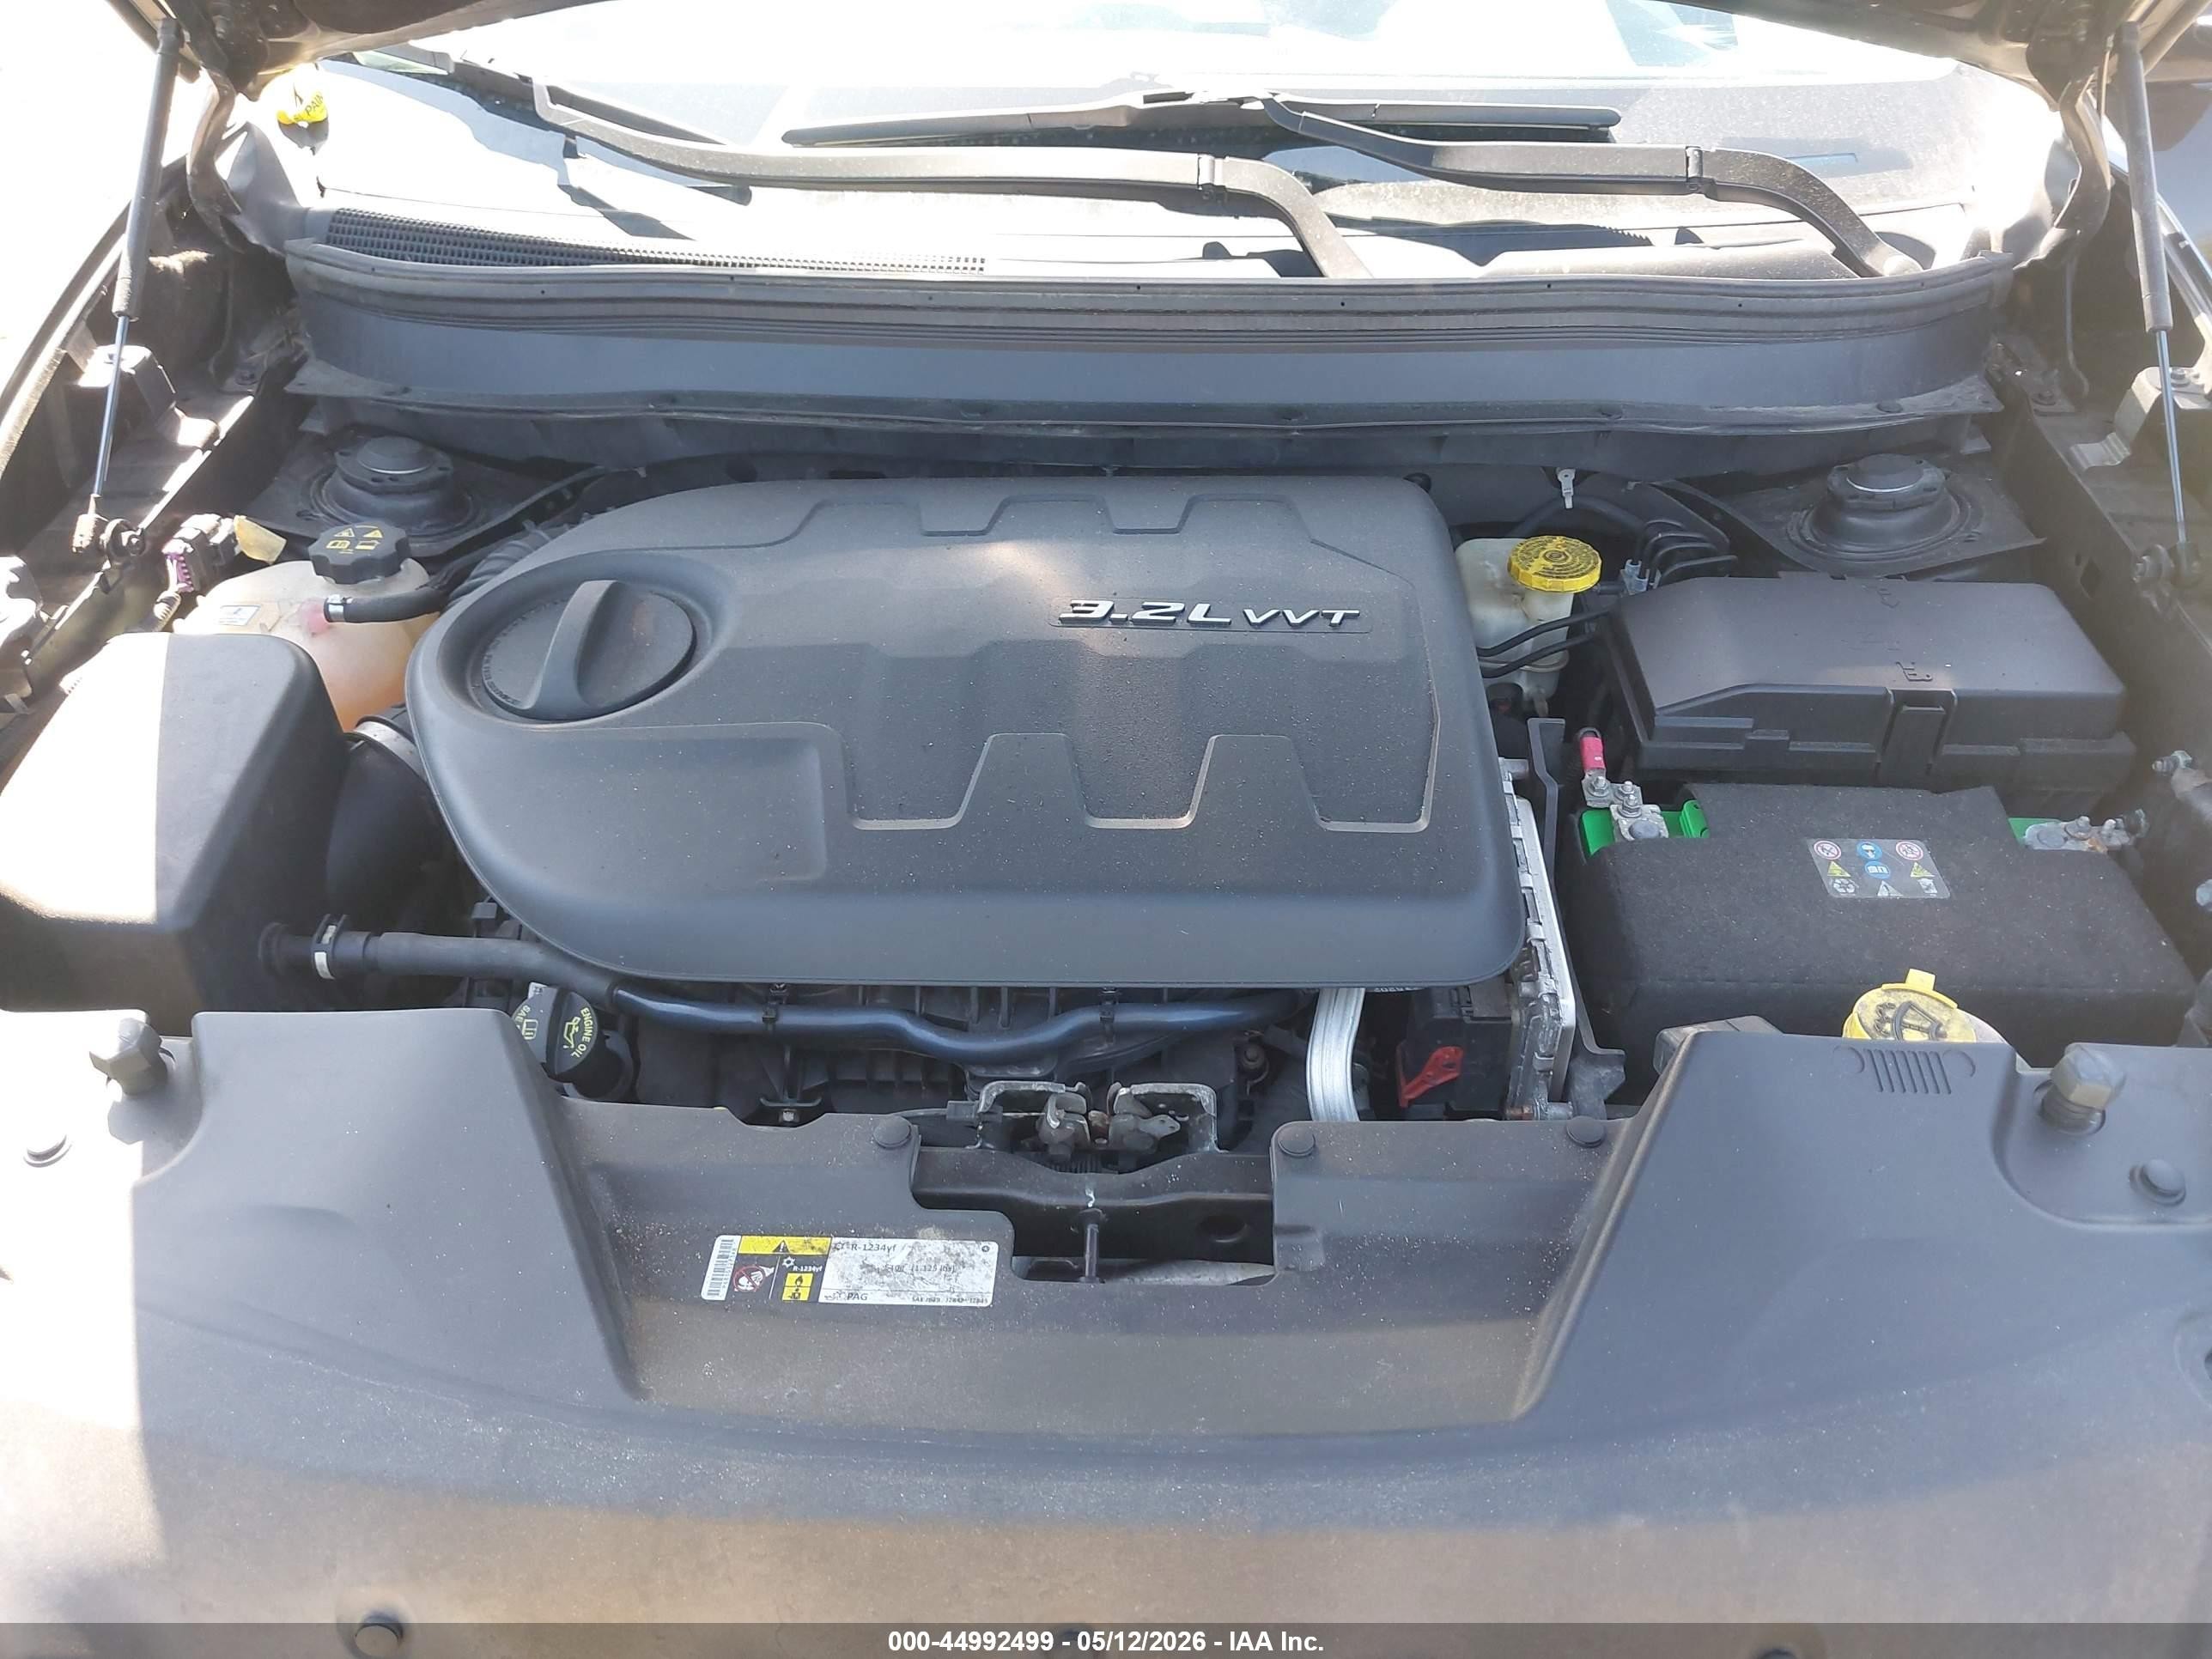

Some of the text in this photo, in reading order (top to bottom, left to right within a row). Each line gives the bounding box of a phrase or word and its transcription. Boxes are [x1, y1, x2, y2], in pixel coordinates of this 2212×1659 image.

[1059, 599, 1360, 626] 3.2L VVT
[570, 1007, 594, 1058] ENGINE OIL
[850, 1243, 896, 1255] R-1234yf
[847, 1292, 868, 1301] PAG
